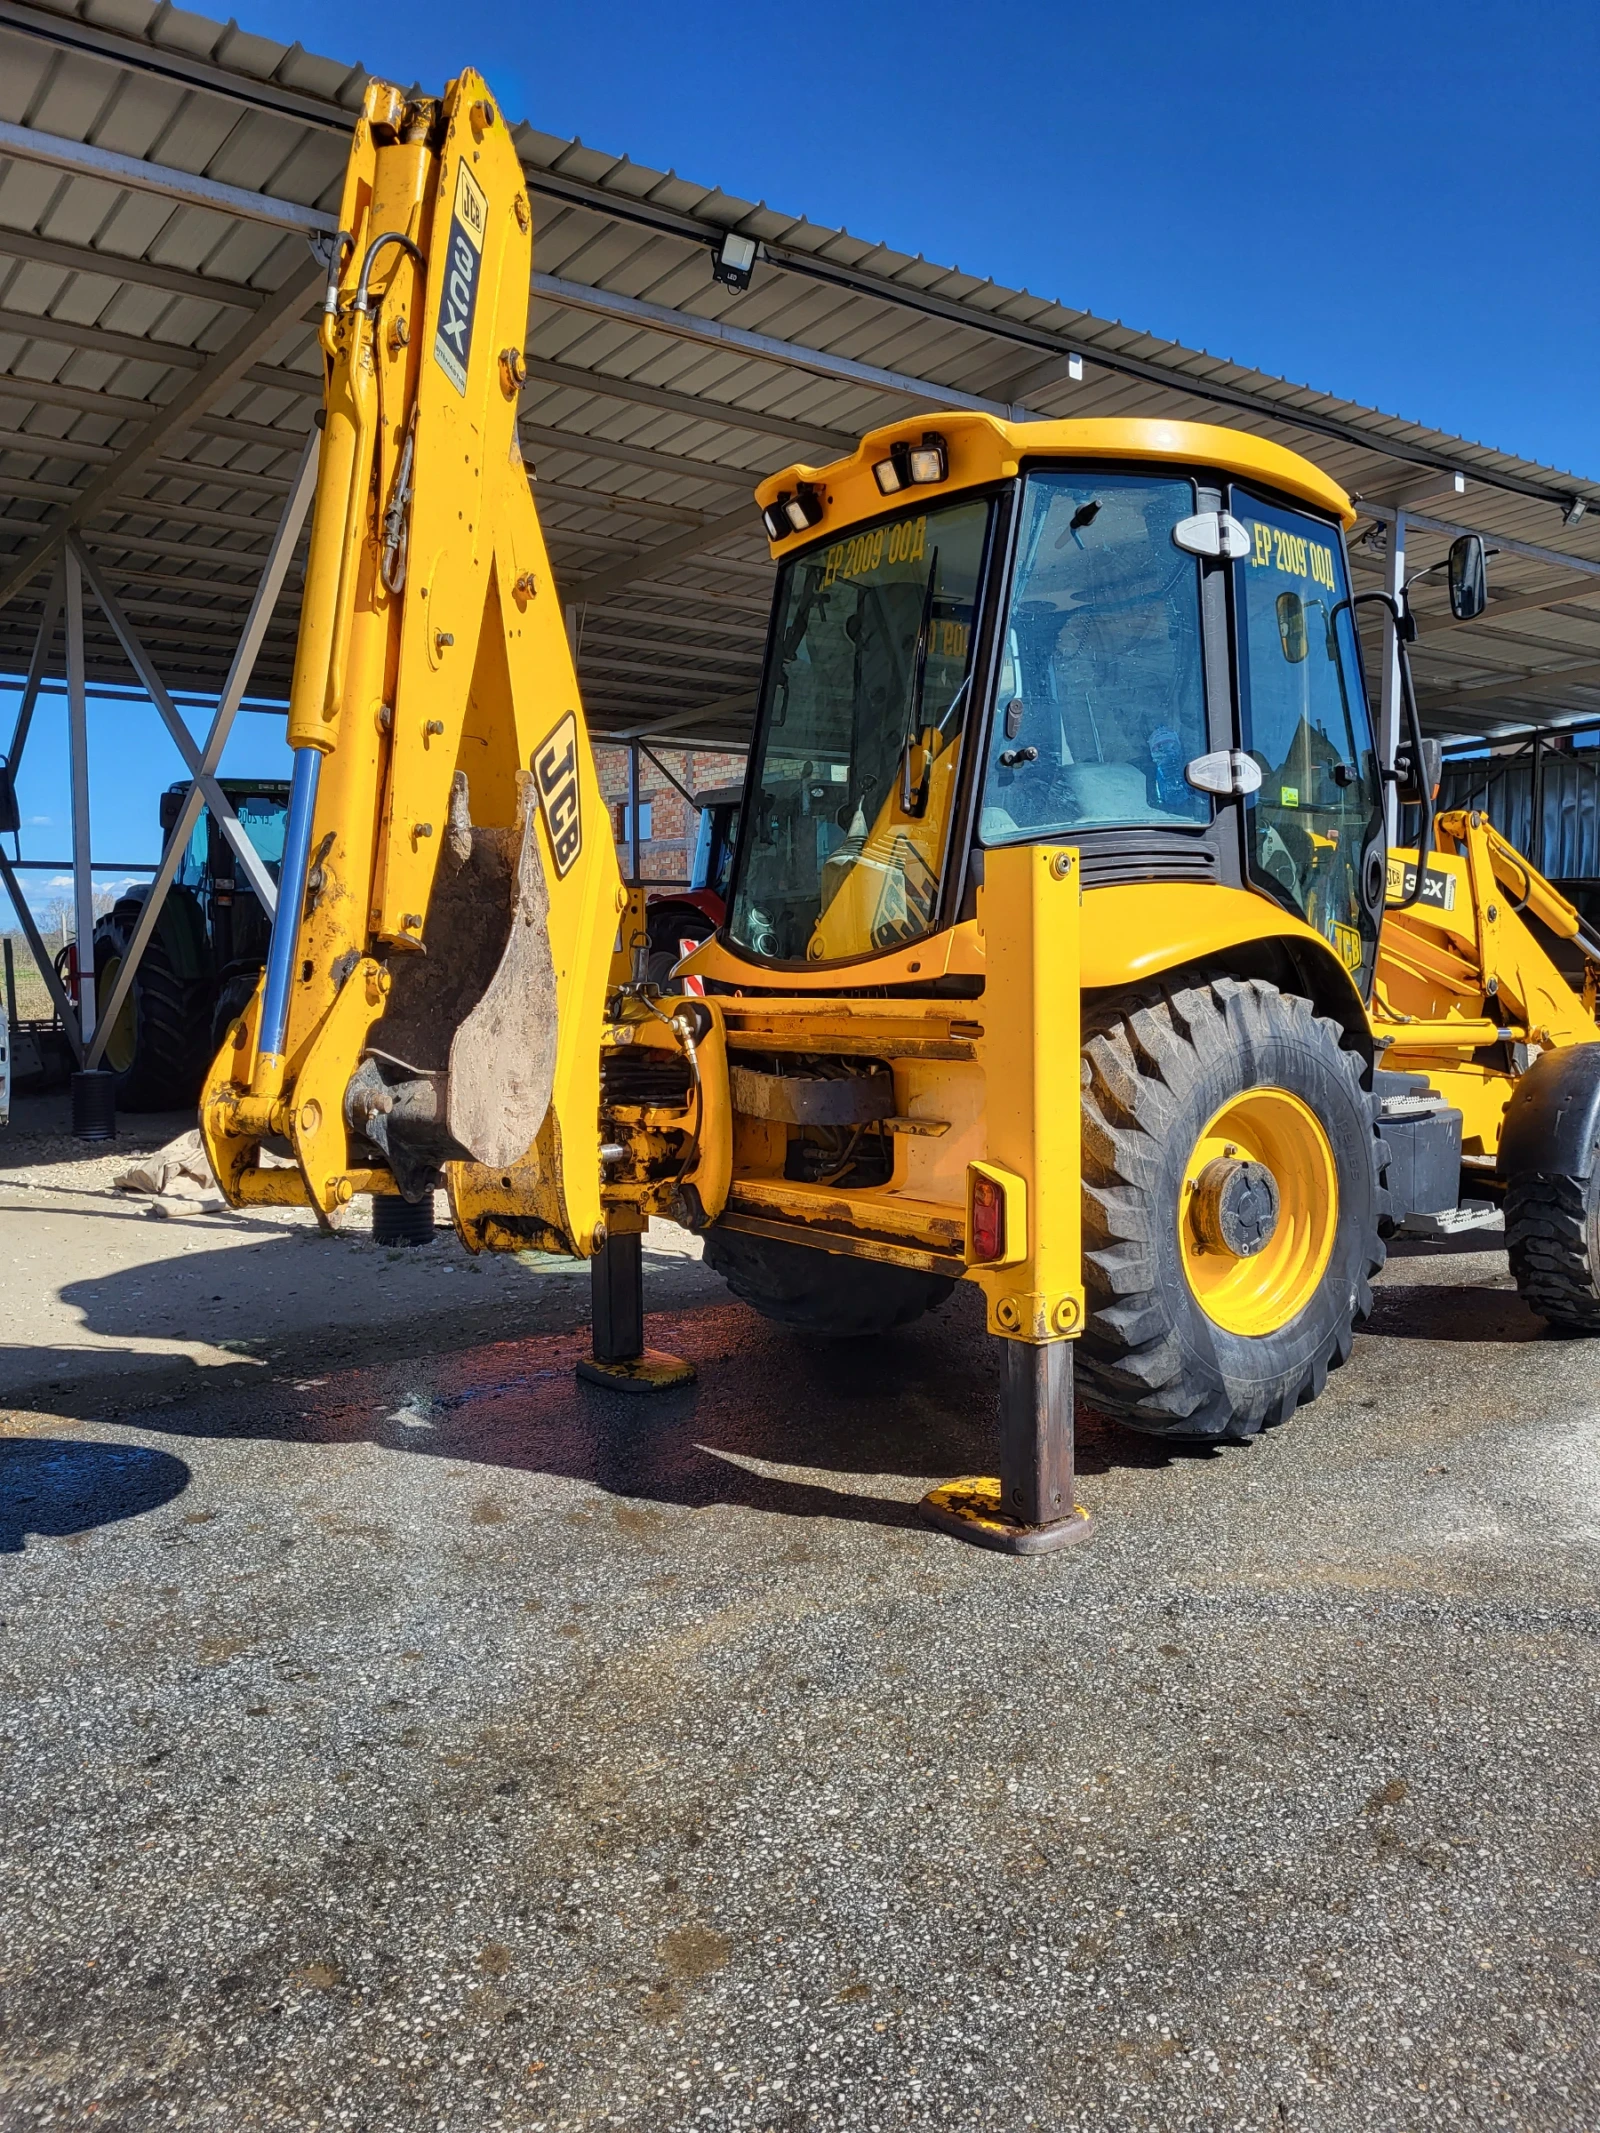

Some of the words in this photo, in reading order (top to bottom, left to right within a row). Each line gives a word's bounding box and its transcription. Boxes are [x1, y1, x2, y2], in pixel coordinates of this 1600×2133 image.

[463, 187, 482, 230] JCB
[443, 235, 474, 356] 3CX
[727, 272, 737, 281] LED
[539, 739, 579, 867] JCB
[1387, 867, 1400, 886] JCB
[1334, 928, 1361, 972] JCB
